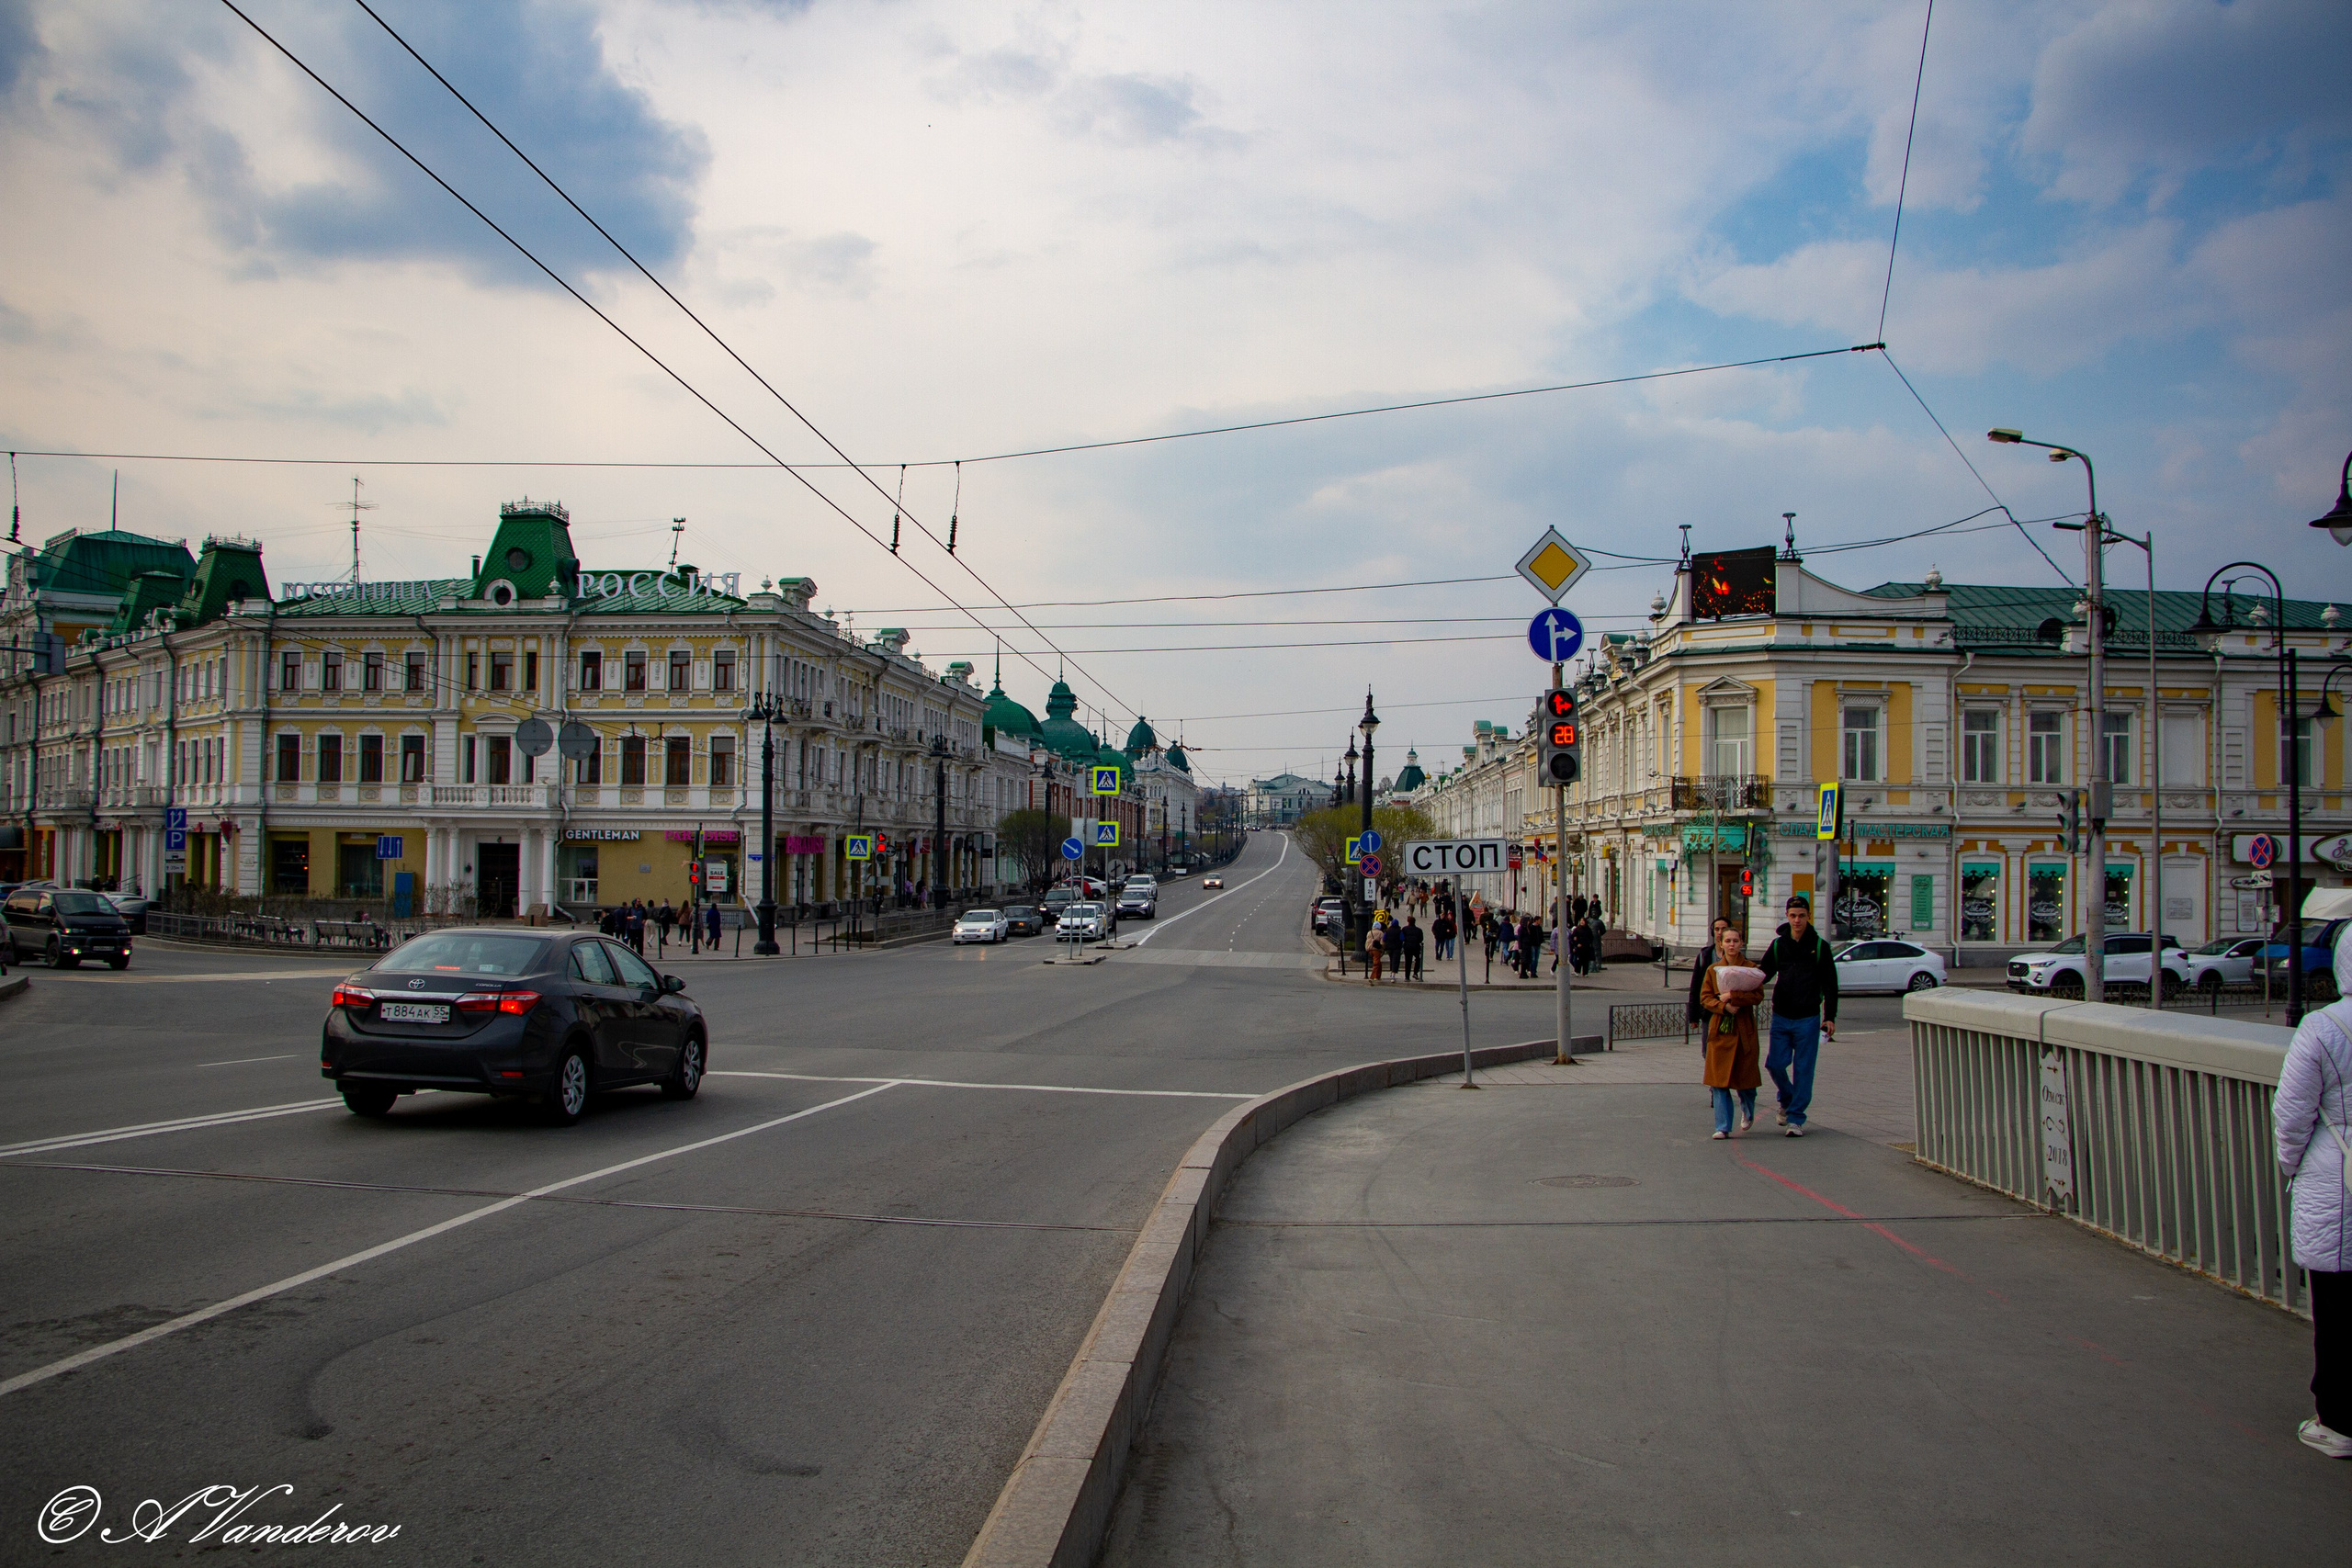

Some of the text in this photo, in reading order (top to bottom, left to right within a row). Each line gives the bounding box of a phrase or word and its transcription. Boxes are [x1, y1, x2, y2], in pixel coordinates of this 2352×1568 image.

[281, 581, 435, 600] ГОСТИНИЦА
[576, 572, 741, 598] РОССИЯ
[1555, 726, 1575, 744] 28
[565, 829, 640, 840] GENTLEMAN
[664, 830, 739, 841] PARDISE
[1780, 822, 1950, 838] СЛАДЯ МАСТЕРСКАЯ
[172, 832, 182, 847] P
[1413, 843, 1498, 870] СТОП
[1742, 885, 1752, 896] 95
[2047, 1145, 2067, 1166] 2018
